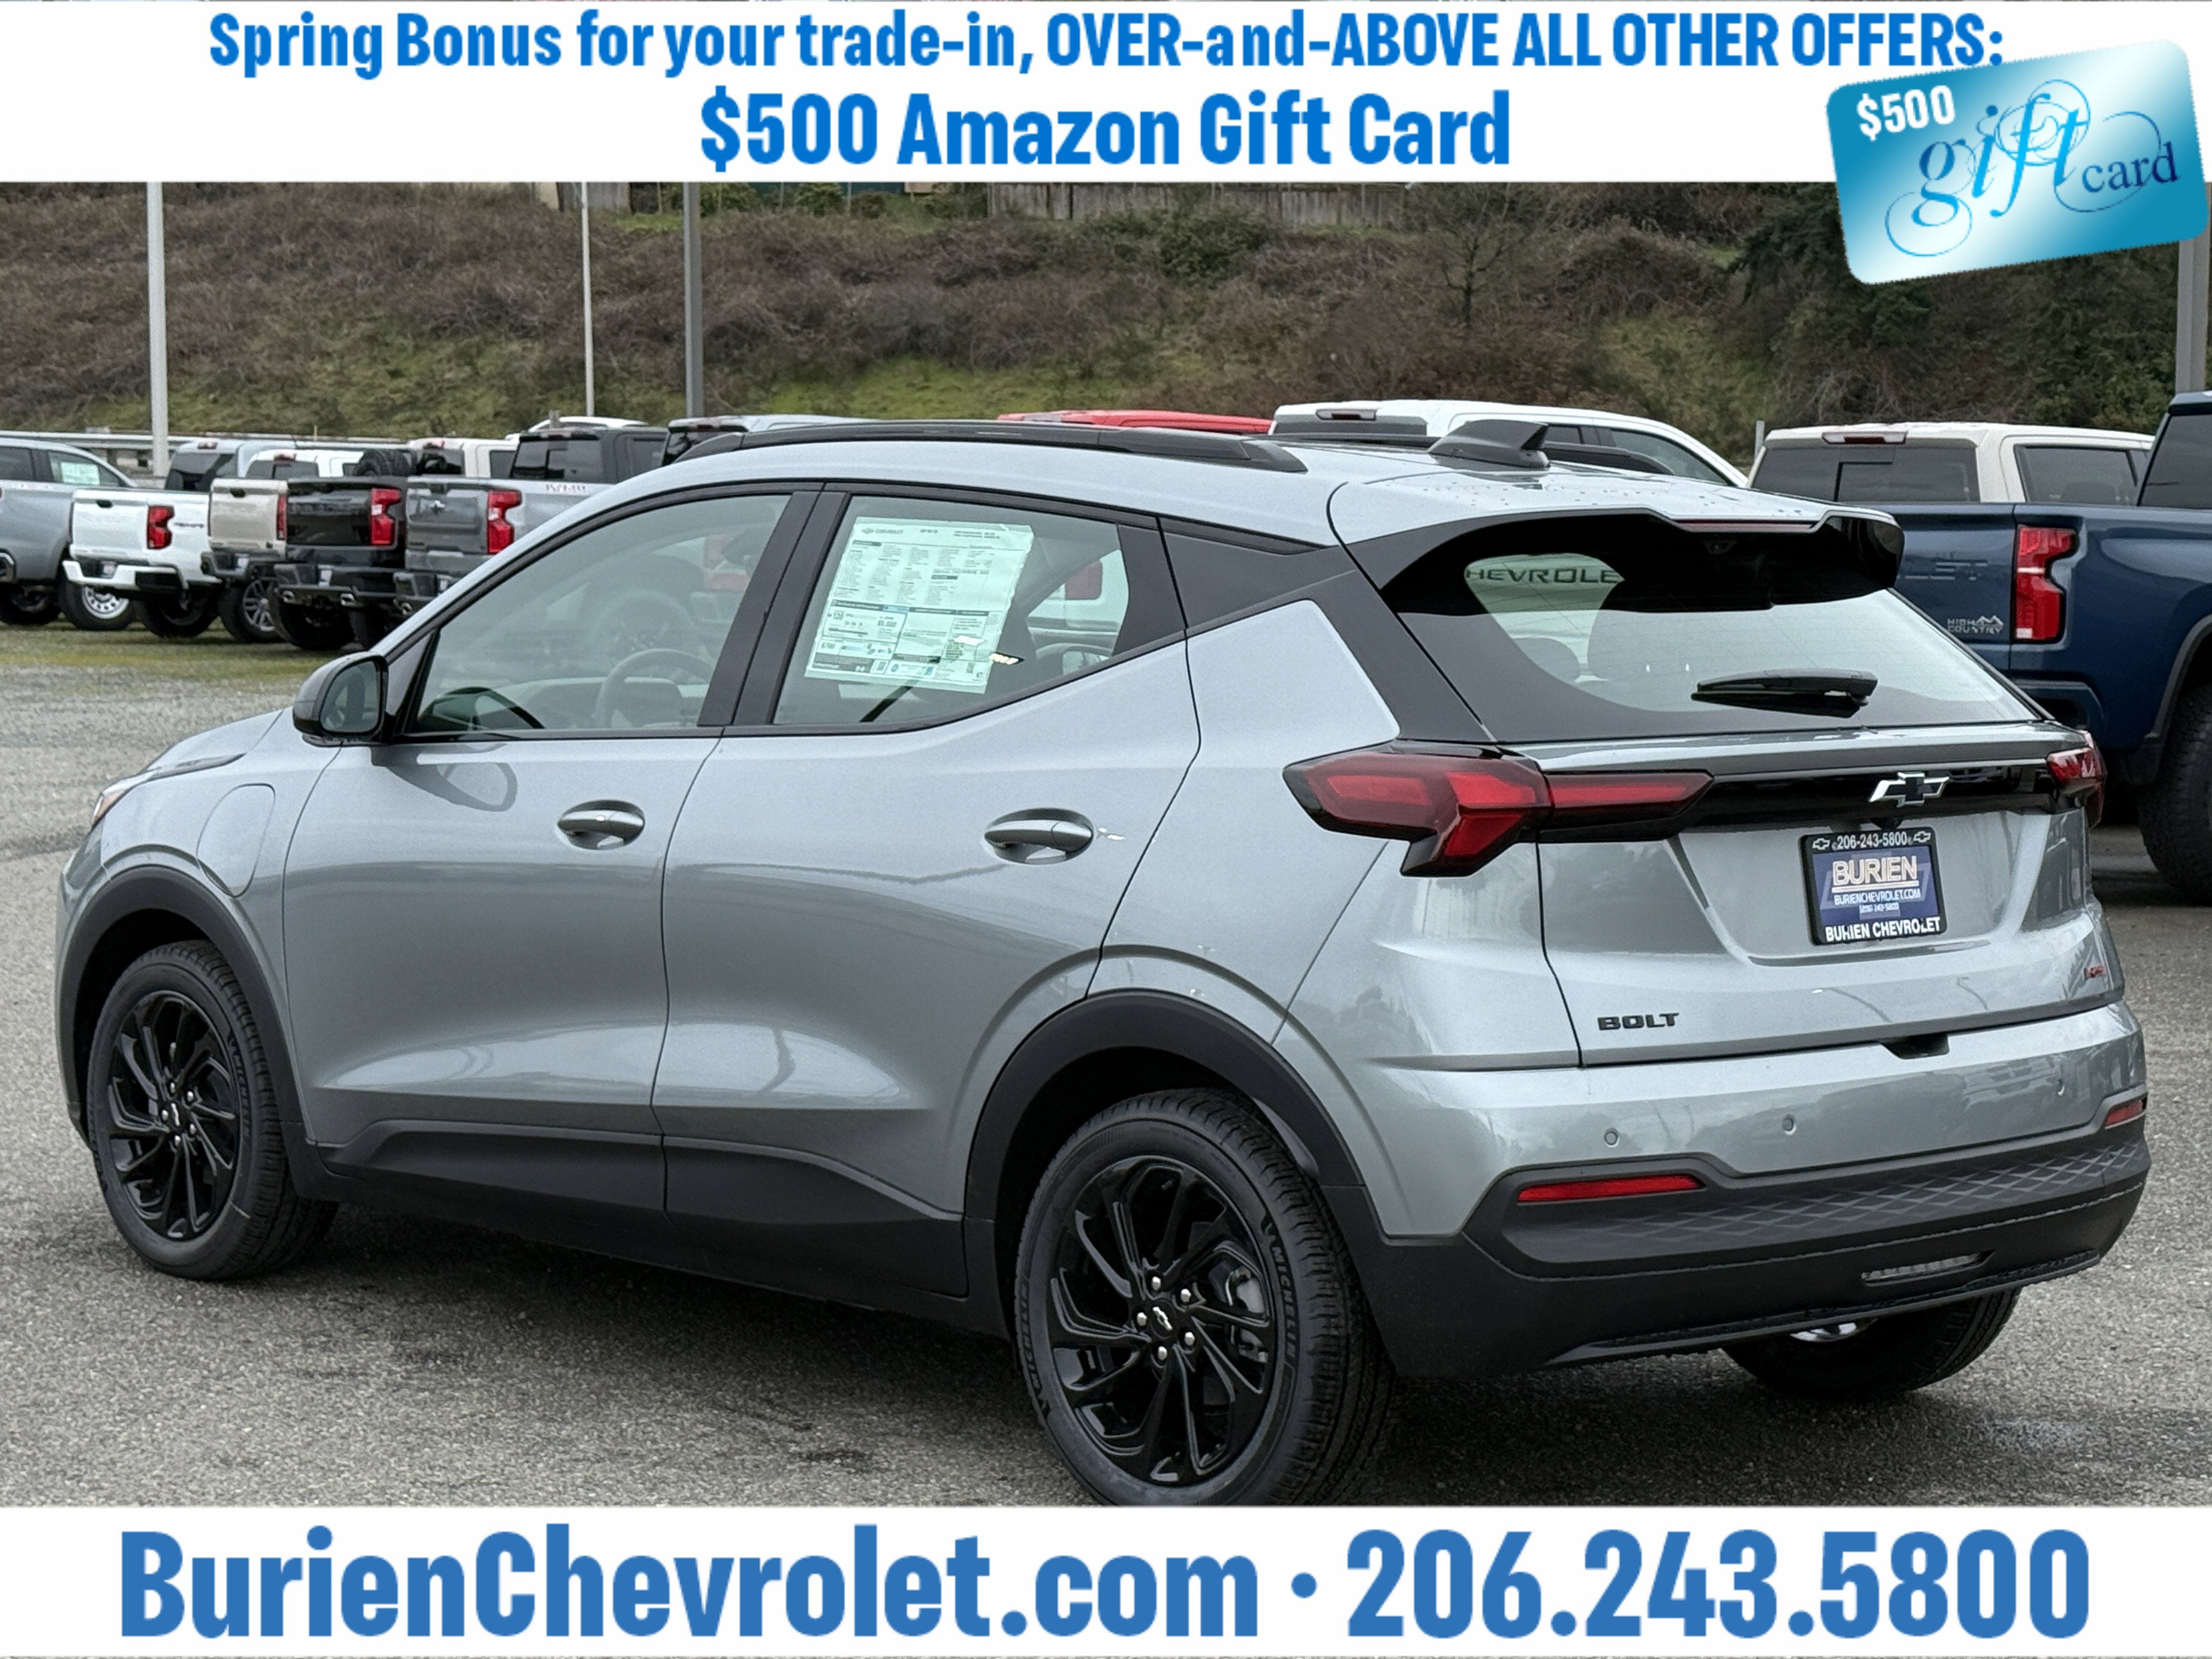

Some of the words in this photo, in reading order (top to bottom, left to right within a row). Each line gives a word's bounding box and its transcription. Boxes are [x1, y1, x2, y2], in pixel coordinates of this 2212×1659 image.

[1465, 568, 1620, 583] HEVROLE
[1837, 831, 1908, 850] 206-243-5800
[1832, 855, 1918, 887] BURIEN
[1833, 888, 1921, 906] BURIENCHEVROLET.COM
[1597, 1012, 1679, 1030] BOLT
[1271, 1245, 1297, 1359] MICHELIN
